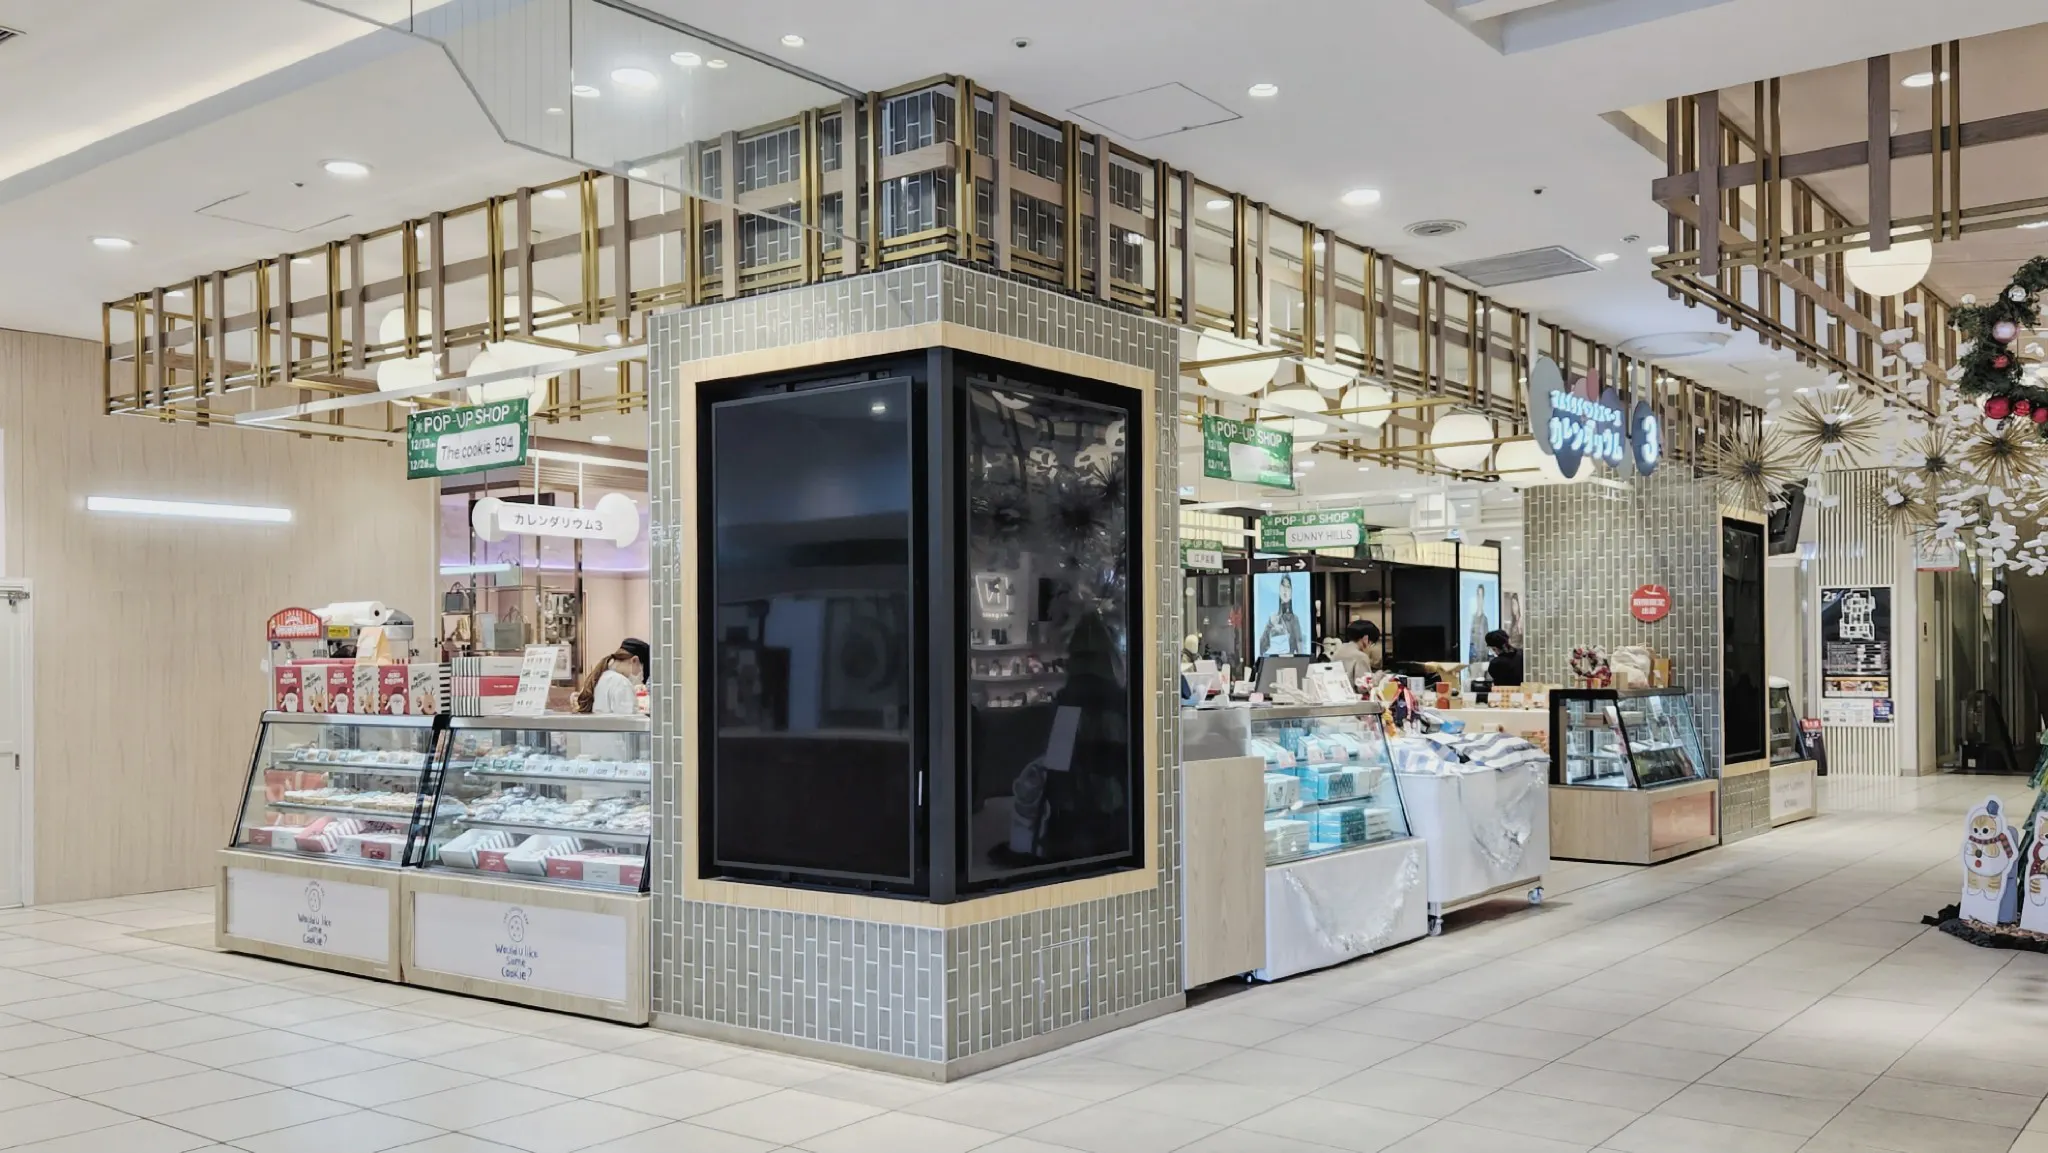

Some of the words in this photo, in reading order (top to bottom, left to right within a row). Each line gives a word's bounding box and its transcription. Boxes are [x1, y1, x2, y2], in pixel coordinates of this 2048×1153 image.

[424, 411, 473, 433] POP-UP
[475, 405, 510, 425] SHOP
[1216, 420, 1255, 442] POP-UP
[1257, 431, 1282, 447] SHOP
[1641, 414, 1658, 463] 3
[441, 445, 460, 461] The
[462, 441, 491, 458] cookie
[494, 436, 514, 453] 594
[513, 512, 604, 531] カレンダリウム3
[1274, 514, 1316, 526] POP-UP
[1319, 512, 1349, 523] SHOP
[1291, 531, 1324, 543] SUNNY
[1326, 529, 1353, 541] HILLS
